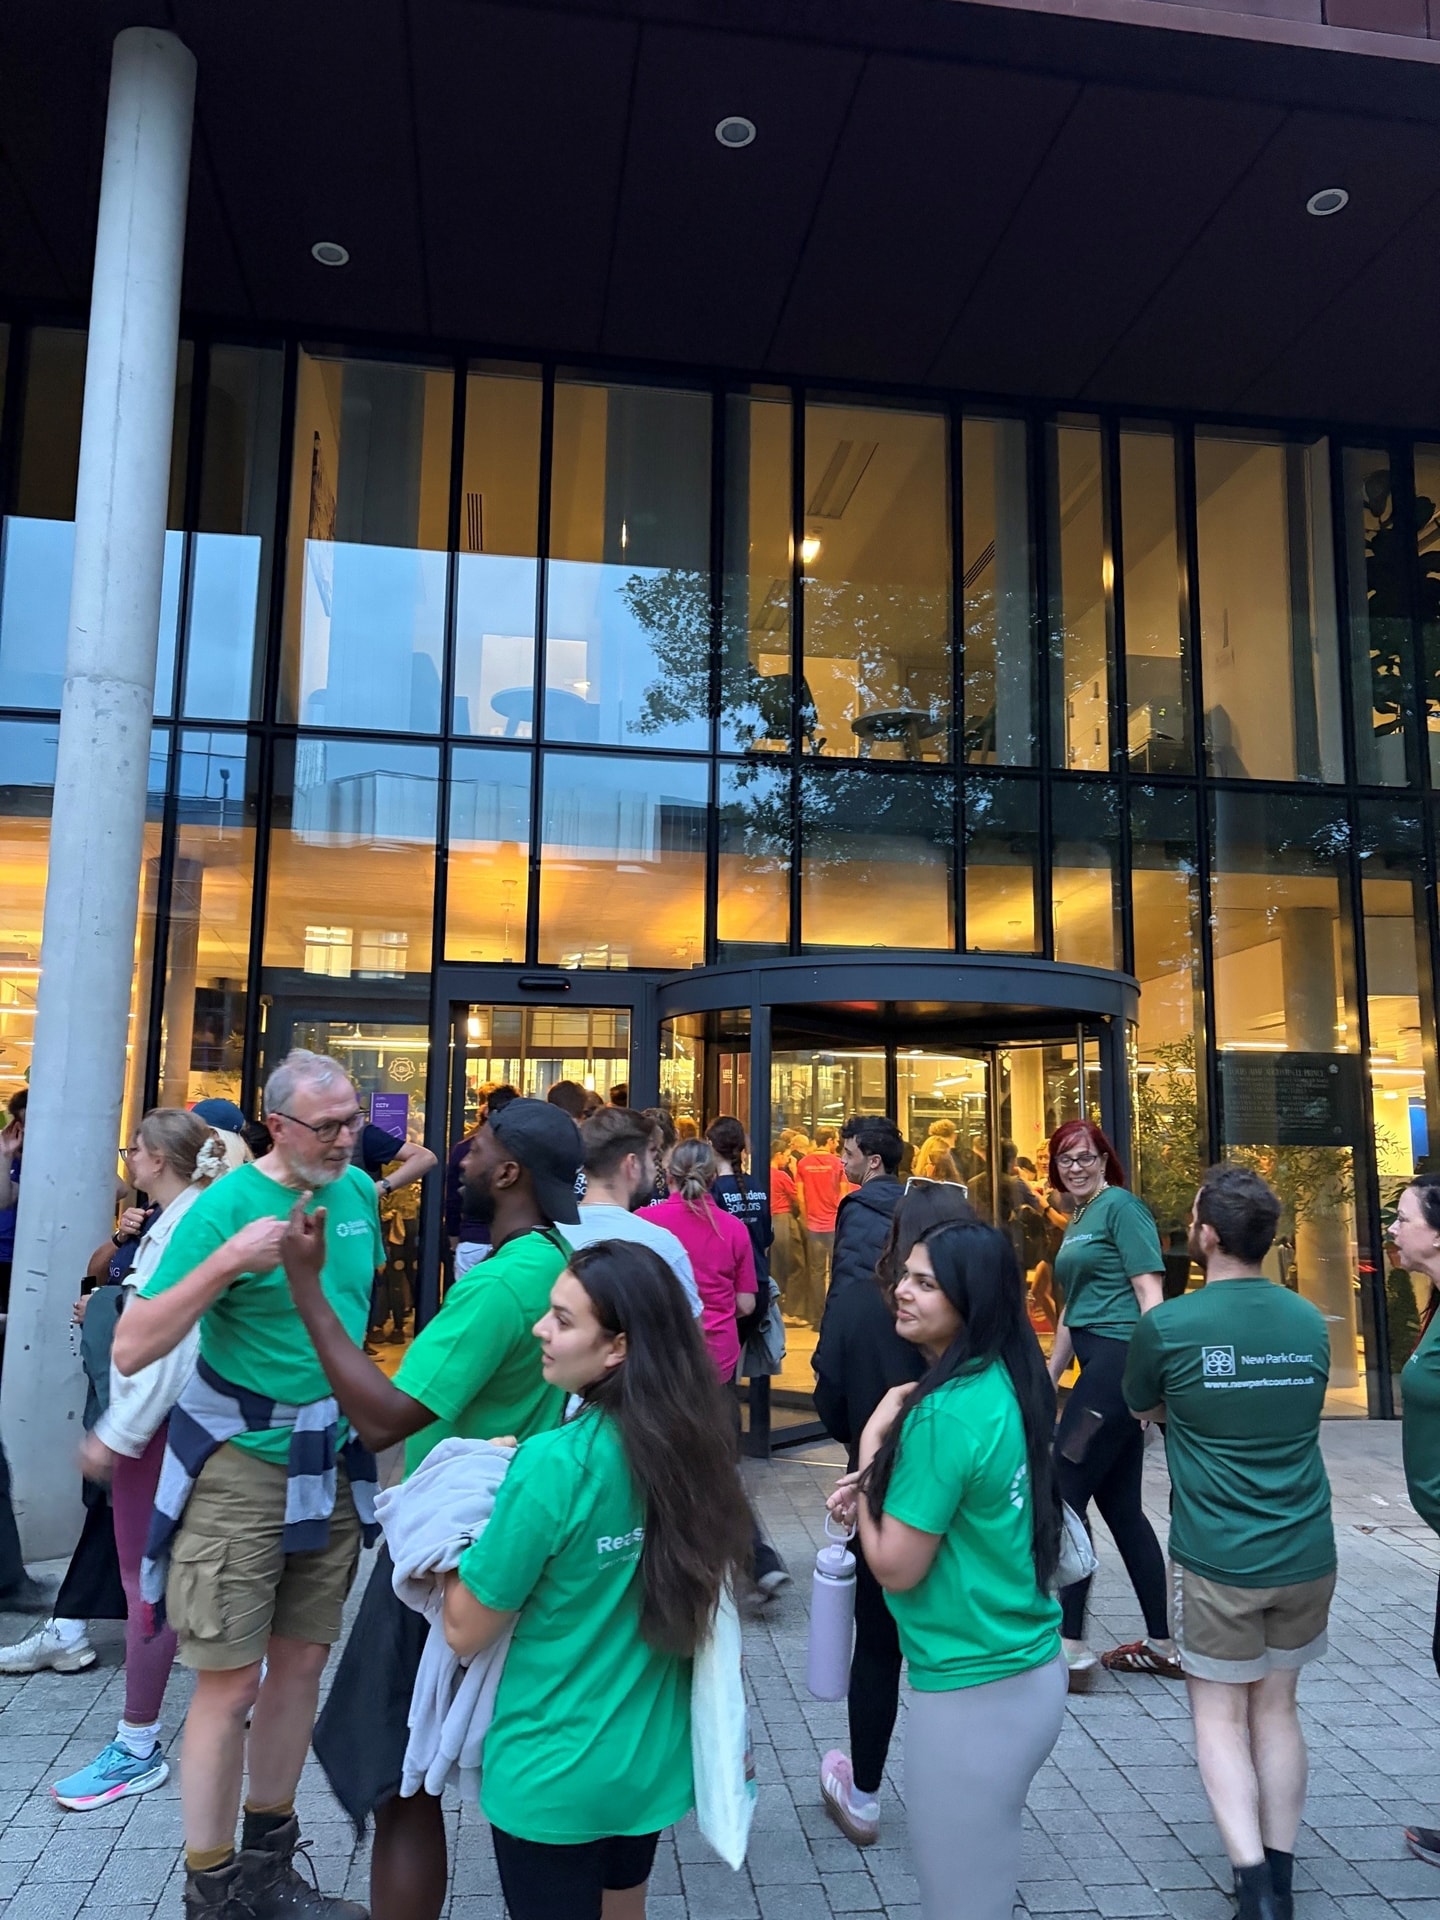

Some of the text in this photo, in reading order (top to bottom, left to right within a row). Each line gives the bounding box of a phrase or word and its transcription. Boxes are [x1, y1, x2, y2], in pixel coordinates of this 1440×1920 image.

[1241, 1353, 1313, 1365] New Park Court
[1203, 1376, 1315, 1389] www.newparkcourt.co.uk
